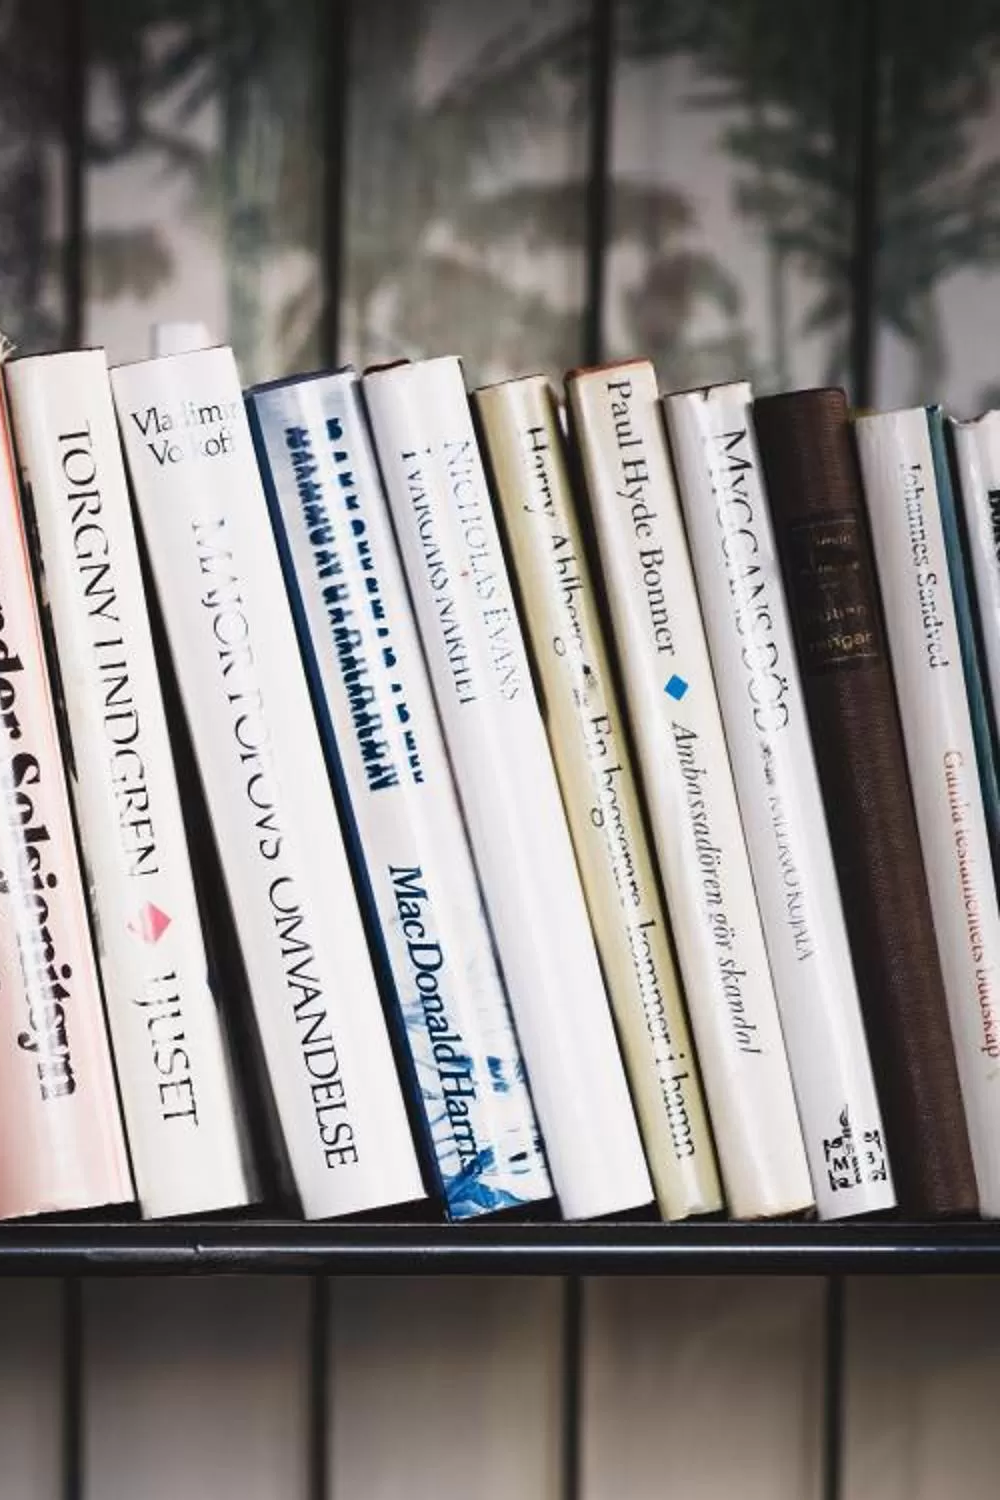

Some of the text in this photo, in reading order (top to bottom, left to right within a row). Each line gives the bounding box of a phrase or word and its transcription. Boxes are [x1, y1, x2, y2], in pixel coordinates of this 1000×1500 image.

[58, 431, 120, 622] TORGNY
[93, 637, 159, 875] LINDGREN
[523, 427, 556, 518] Harry
[607, 380, 762, 1054] Paul Hyde Bonner Ambassadören gör skandal
[268, 876, 359, 1169] OMVANDELSE
